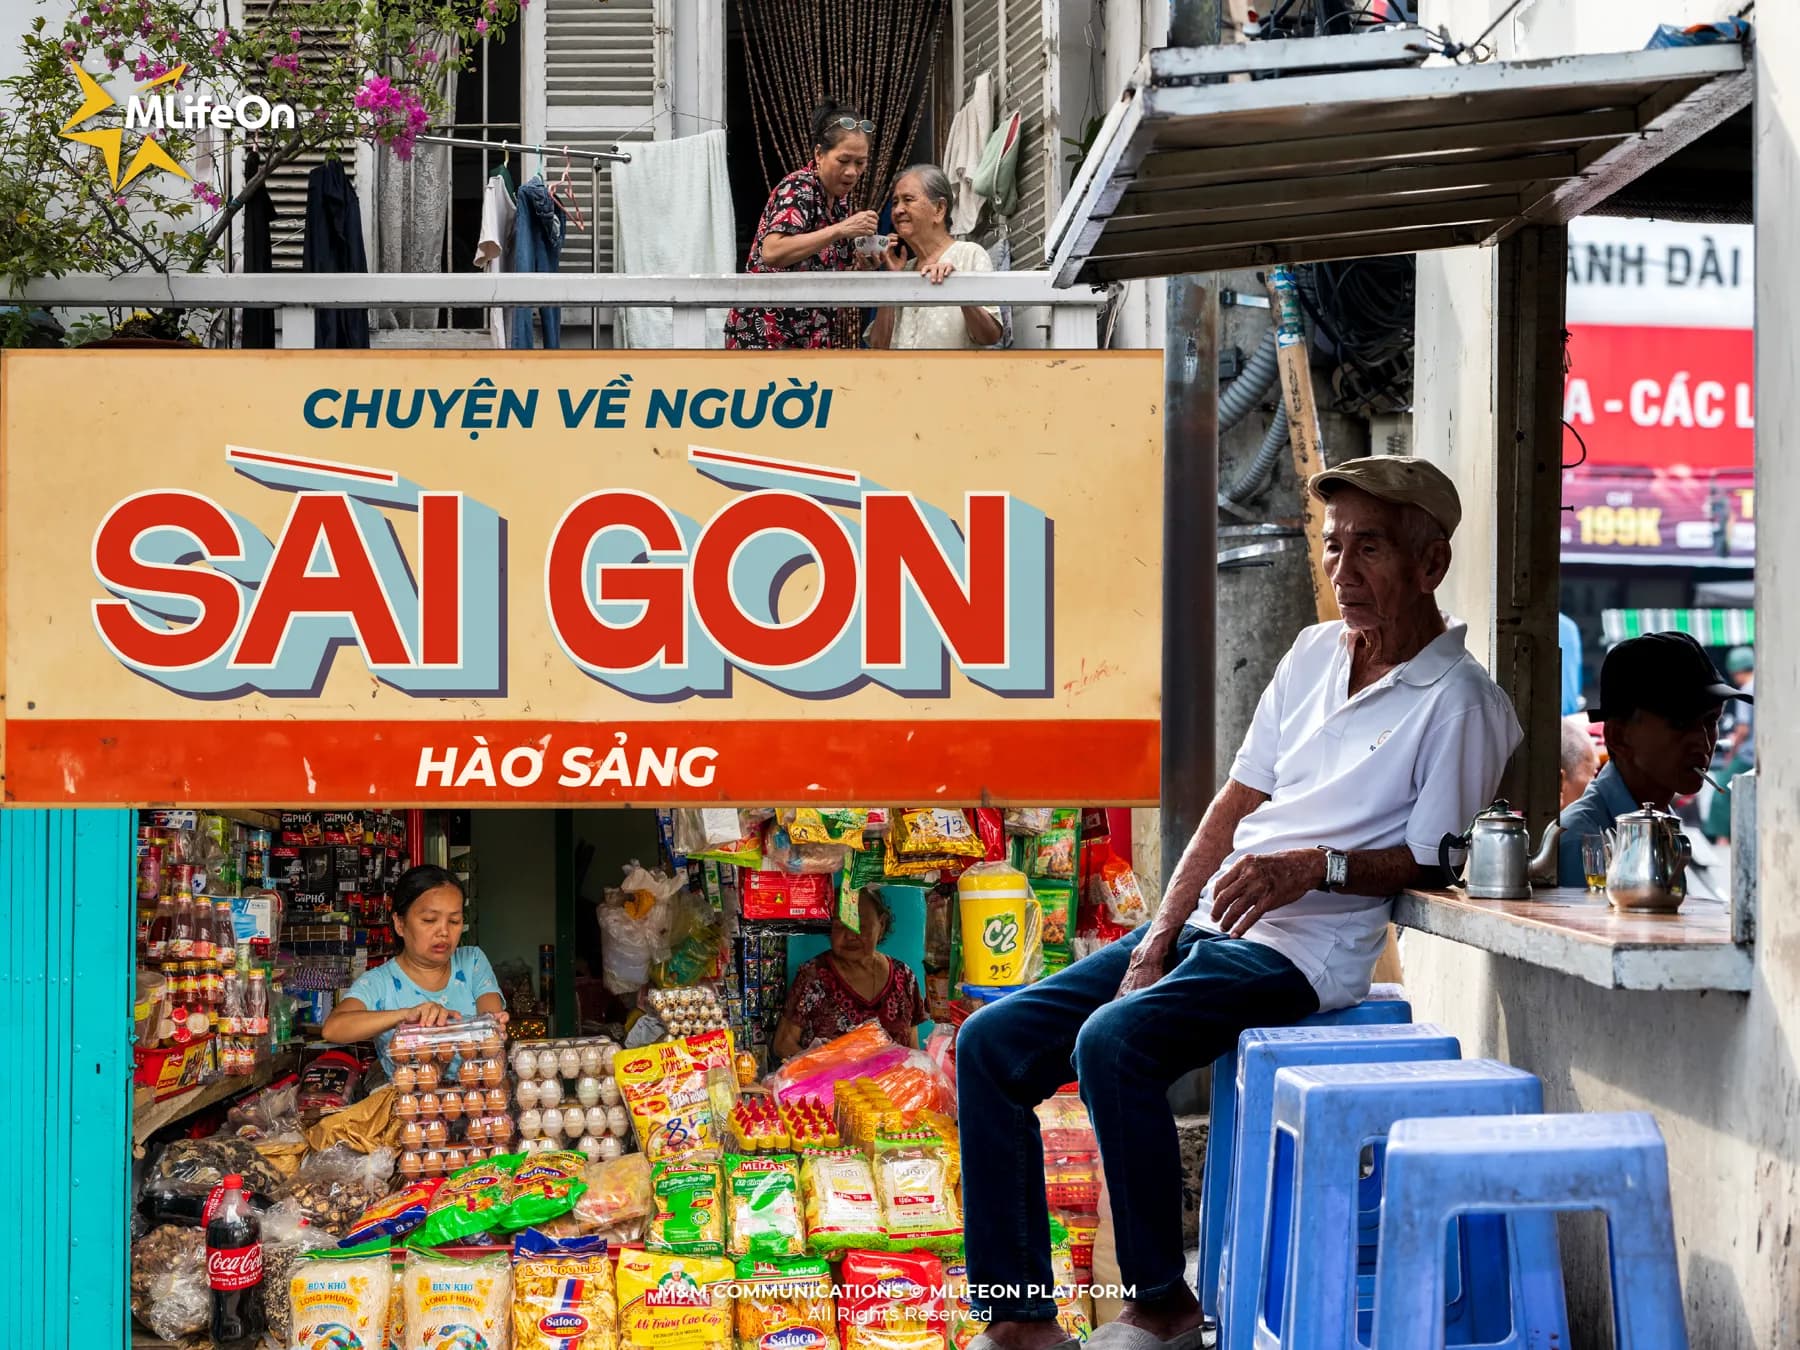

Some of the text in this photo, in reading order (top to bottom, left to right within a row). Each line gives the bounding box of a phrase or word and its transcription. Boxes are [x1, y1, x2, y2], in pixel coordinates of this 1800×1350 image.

[303, 374, 834, 440] CHUYỆN VỀ NGƯỜI
[1630, 371, 1725, 428] CÁC
[1576, 506, 1662, 546] 199K
[91, 444, 1018, 680] SÀI GÒN
[558, 732, 719, 787] SẢNG
[938, 815, 963, 835] 75
[983, 919, 1018, 952] C2
[988, 962, 1012, 980] 25
[666, 1117, 708, 1147] 85
[552, 1261, 602, 1275] NOODLES
[546, 1316, 582, 1327] Safoco
[682, 1314, 699, 1325] Cao
[769, 1332, 817, 1346] Safoco
